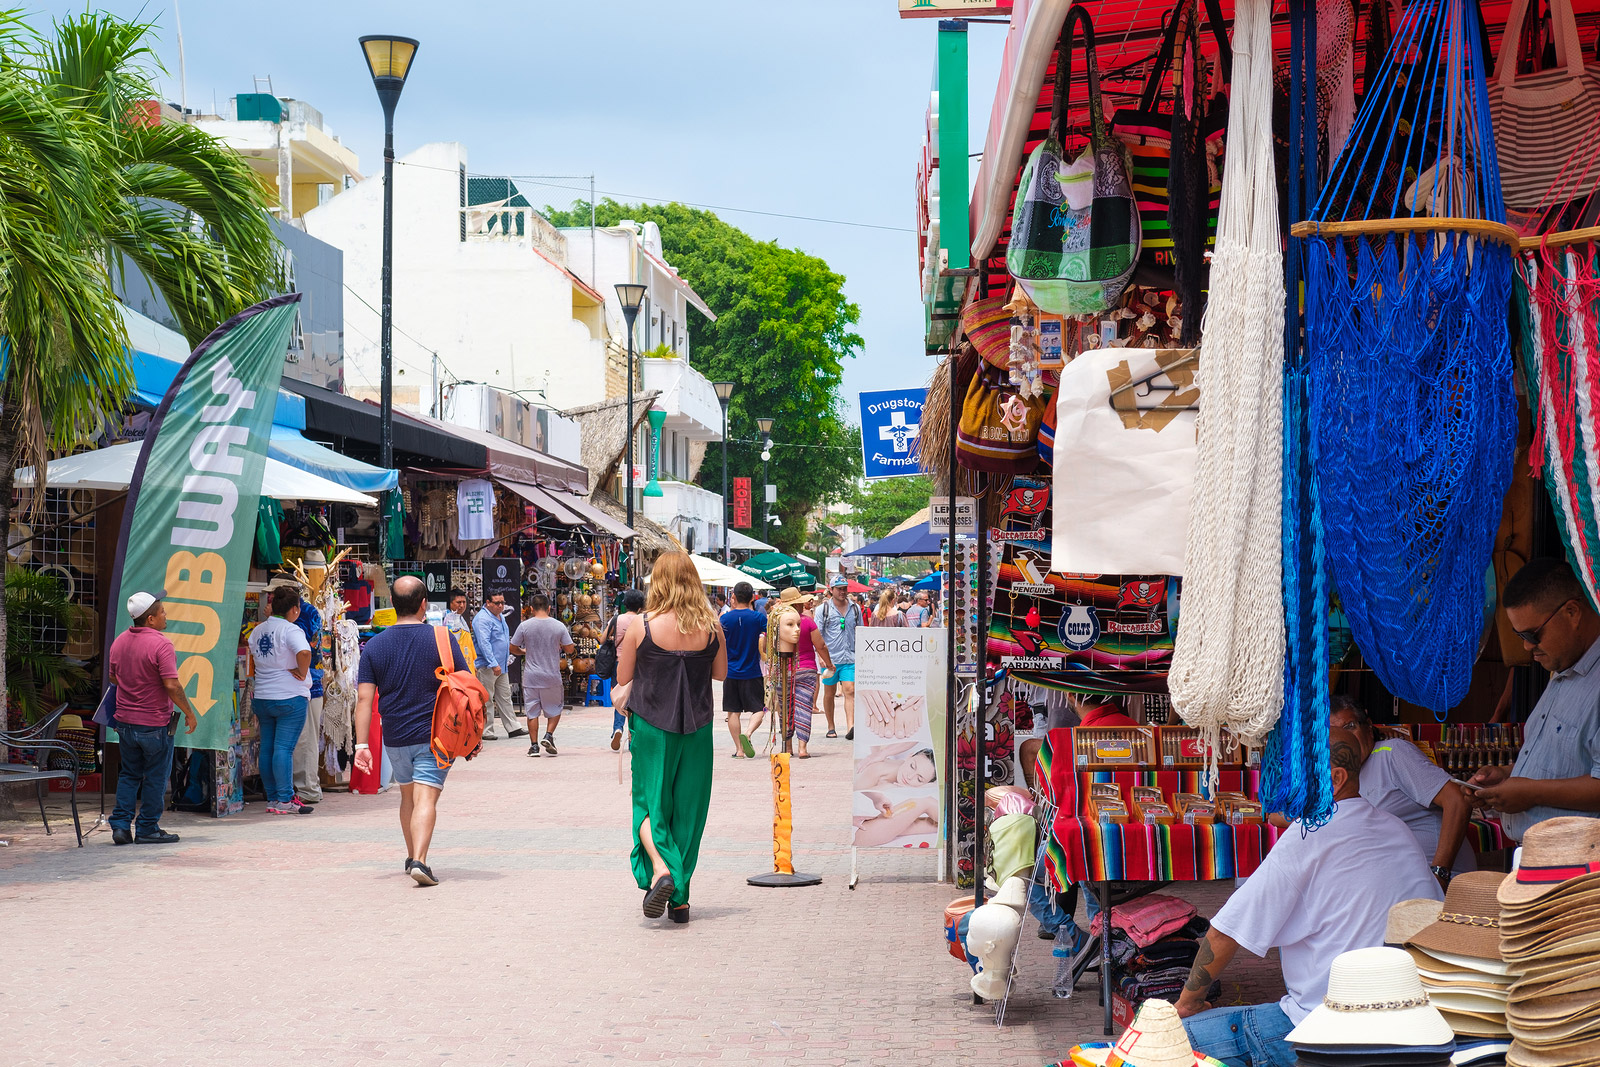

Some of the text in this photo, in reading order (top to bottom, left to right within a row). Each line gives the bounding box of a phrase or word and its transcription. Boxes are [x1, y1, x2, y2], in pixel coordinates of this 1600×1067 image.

[872, 452, 920, 467] Farmac
[467, 498, 485, 514] 22
[736, 479, 747, 526] HOTEL
[933, 516, 972, 526] SUNGASSES
[163, 354, 257, 717] SUBWAY
[1012, 586, 1053, 594] PENGUINS
[1067, 622, 1091, 636] COLTS
[1001, 661, 1061, 670] CARDINALS
